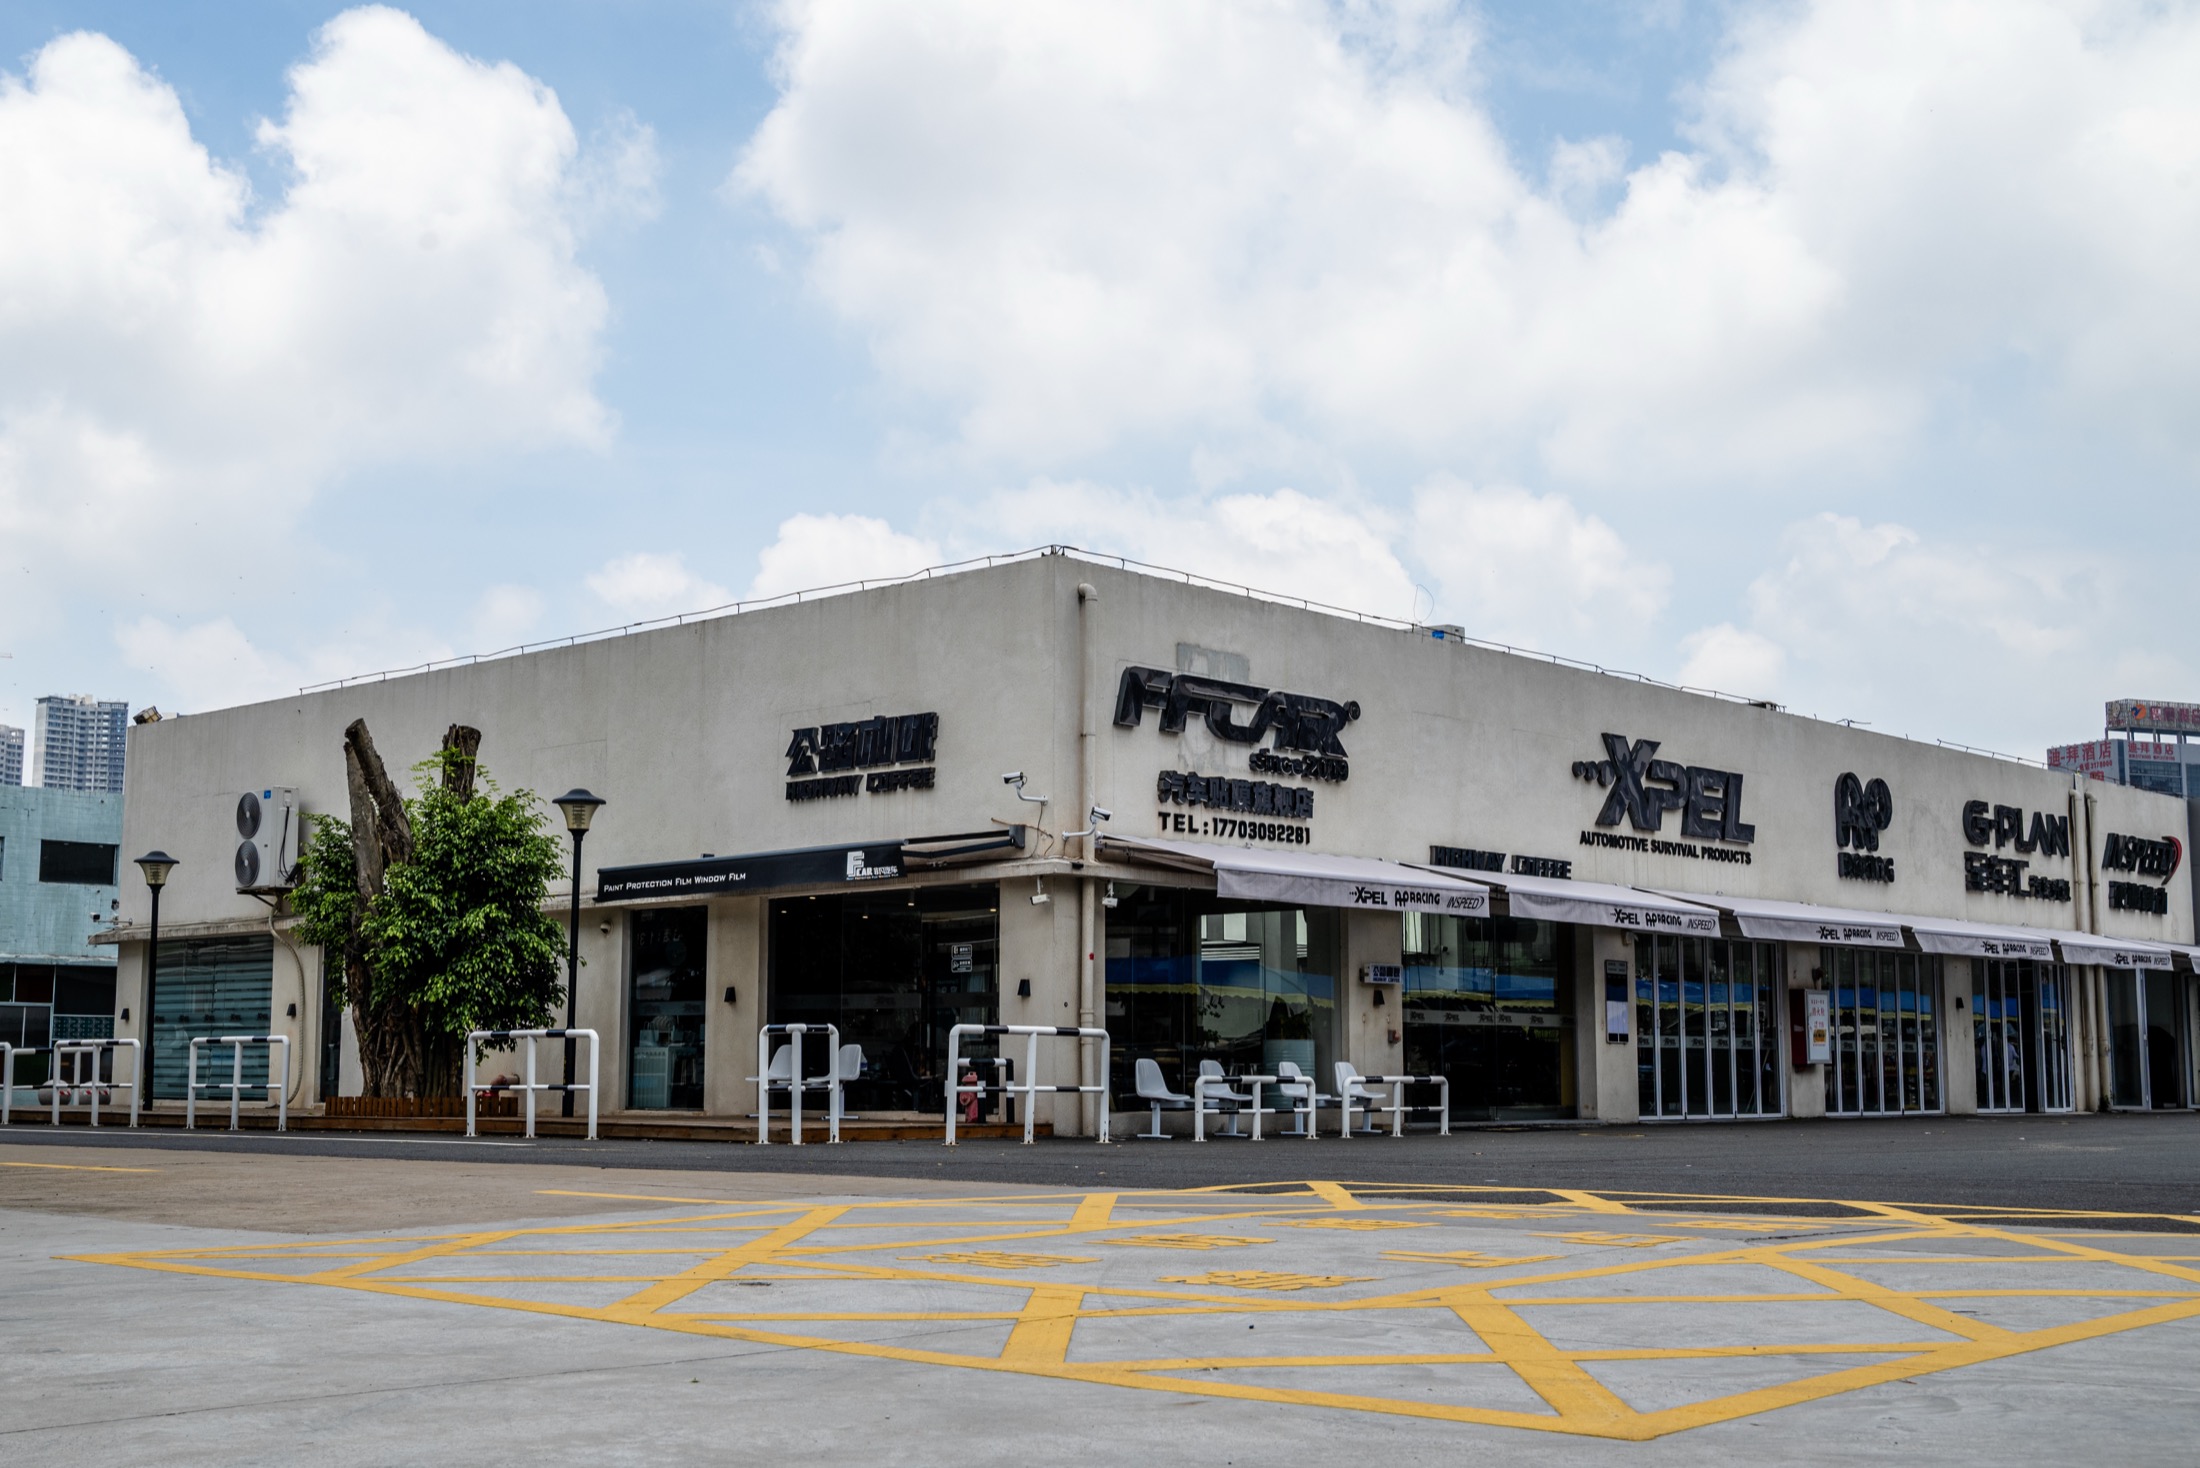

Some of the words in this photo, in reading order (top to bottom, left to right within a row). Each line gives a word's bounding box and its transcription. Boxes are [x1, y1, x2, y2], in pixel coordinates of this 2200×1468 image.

[785, 774, 864, 801] HIGHWAY
[866, 767, 936, 792] COFFEE
[1157, 770, 1314, 819] 汽车贴膜旗舰店
[1595, 732, 1755, 844] XPEL
[1212, 817, 1310, 845] 17703092281
[1429, 845, 1506, 873] HIGHWAY
[1511, 855, 1572, 880] COFFEE
[1579, 831, 1649, 852] AUTOMOTIVE
[1650, 839, 1699, 859] SURVIVAL
[1701, 849, 1752, 865] PRODUCTS
[604, 884, 623, 893] PAINT
[626, 879, 673, 890] PROTECTION
[675, 877, 692, 886] FILM
[694, 874, 726, 884] WINDOW
[728, 872, 746, 881] FILM
[1354, 886, 1388, 905] XPEL
[1446, 896, 1479, 910] INSPEED
[1613, 908, 1640, 925] XPEL
[1819, 926, 1840, 941] XPEL
